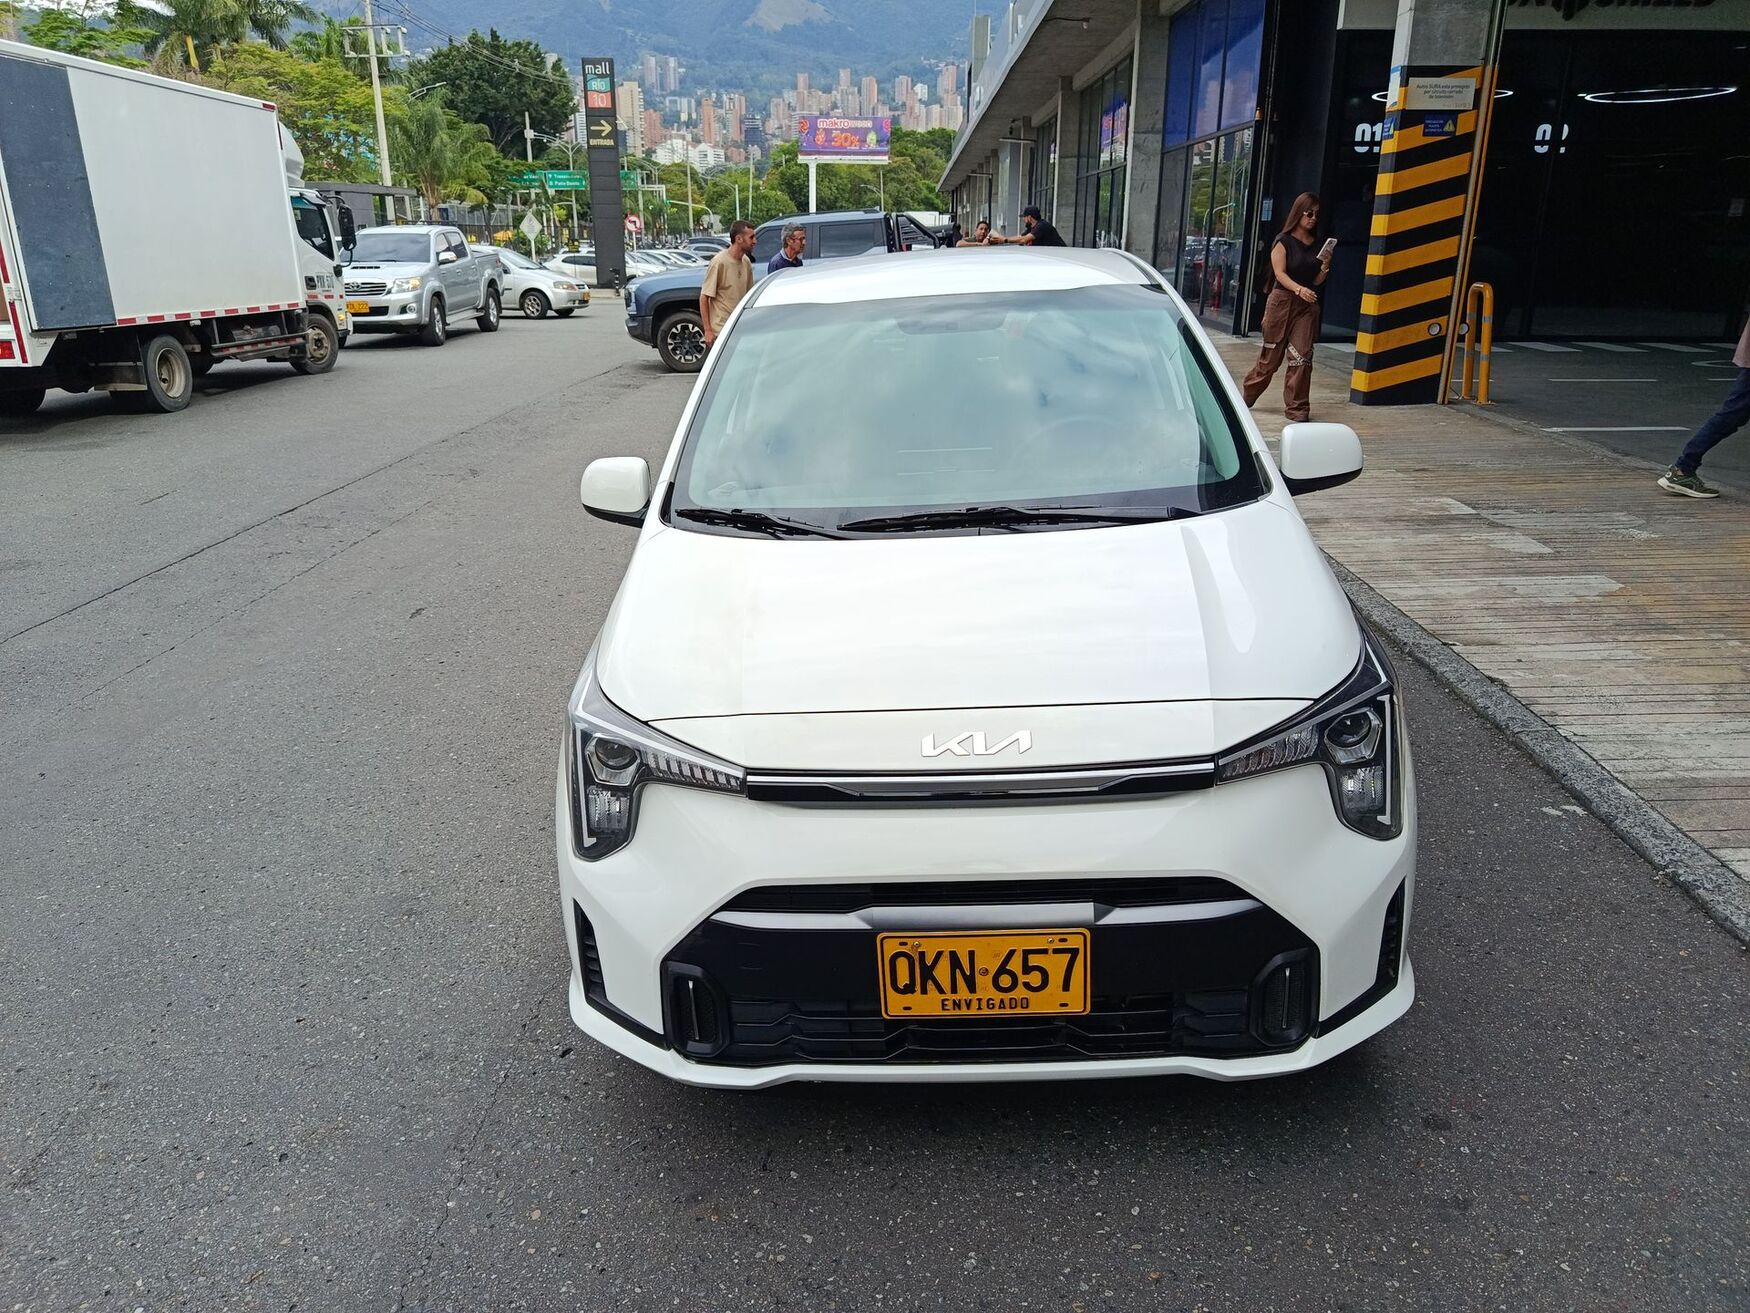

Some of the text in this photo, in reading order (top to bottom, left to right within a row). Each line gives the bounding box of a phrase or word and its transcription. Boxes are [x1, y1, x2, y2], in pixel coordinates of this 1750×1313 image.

[585, 61, 611, 75] mall
[592, 93, 607, 107] 10
[1354, 122, 1383, 153] 01
[920, 729, 1033, 758] KIA
[888, 947, 1081, 996] QKN 657
[940, 996, 1030, 1012] ENVIGADO
